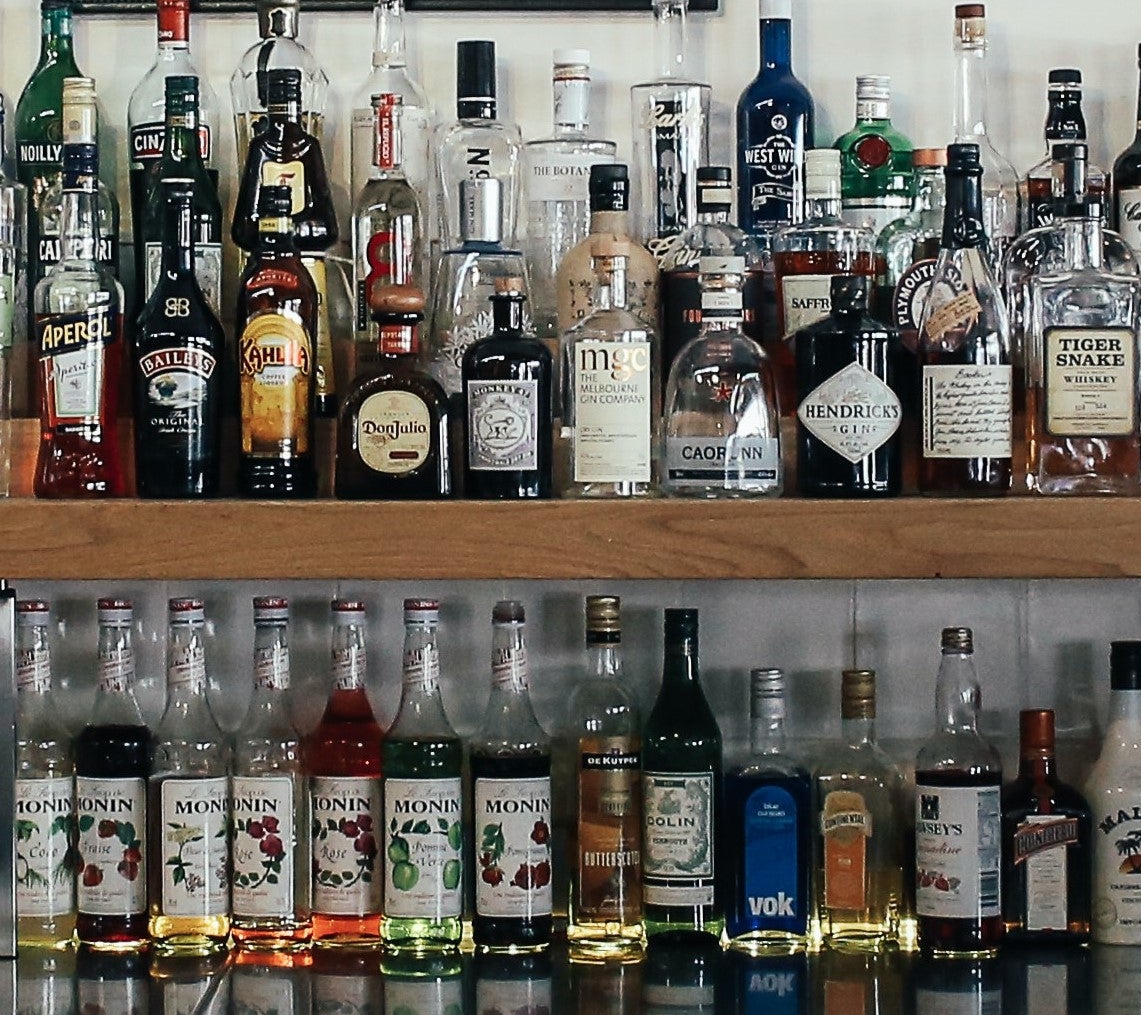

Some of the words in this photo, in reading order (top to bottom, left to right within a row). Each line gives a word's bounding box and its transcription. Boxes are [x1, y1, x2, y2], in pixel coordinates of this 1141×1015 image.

[20, 144, 62, 162] NOILLY
[745, 148, 775, 164] WEST
[553, 165, 591, 176] BOTAN
[792, 297, 831, 309] SAFFR
[42, 317, 112, 351] APEROL
[1058, 338, 1122, 352] TIGER
[144, 351, 212, 372] BAILEYS
[239, 337, 310, 375] KAHLA
[1056, 354, 1125, 367] SNAKE
[581, 348, 646, 381] mgc
[580, 373, 598, 383] THE
[1063, 375, 1118, 384] WHISKEY
[580, 384, 638, 394] MELBOURNE
[580, 395, 598, 404] GIN
[599, 395, 646, 404] COMPANY
[805, 404, 899, 420] HENDRICK'S
[840, 425, 872, 434] GIN
[395, 799, 460, 814] MONIN
[485, 799, 550, 814] MONIN
[747, 891, 795, 917] vok
